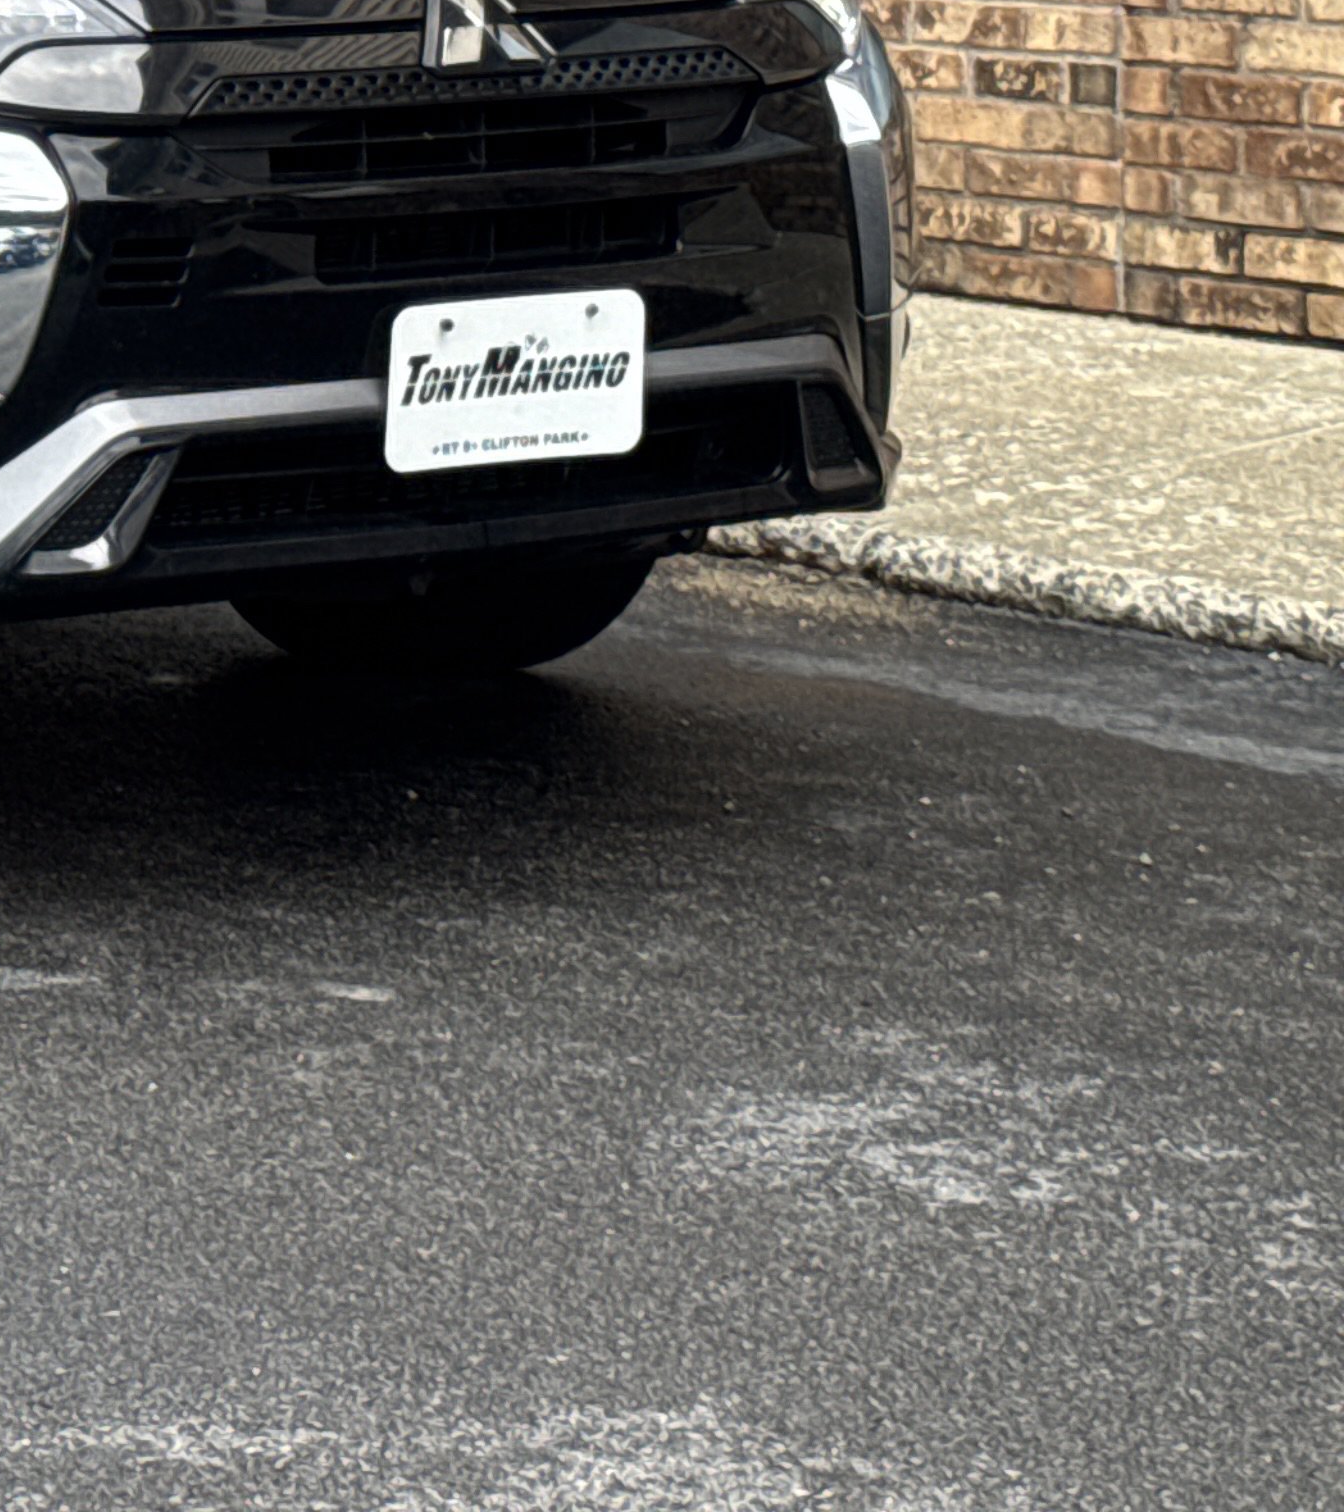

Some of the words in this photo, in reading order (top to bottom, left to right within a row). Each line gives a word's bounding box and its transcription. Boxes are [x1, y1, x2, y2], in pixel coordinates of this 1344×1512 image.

[400, 353, 480, 406] TONY
[474, 345, 631, 398] MANGINO
[481, 435, 539, 452] CLIFTON
[543, 431, 580, 446] PARK
